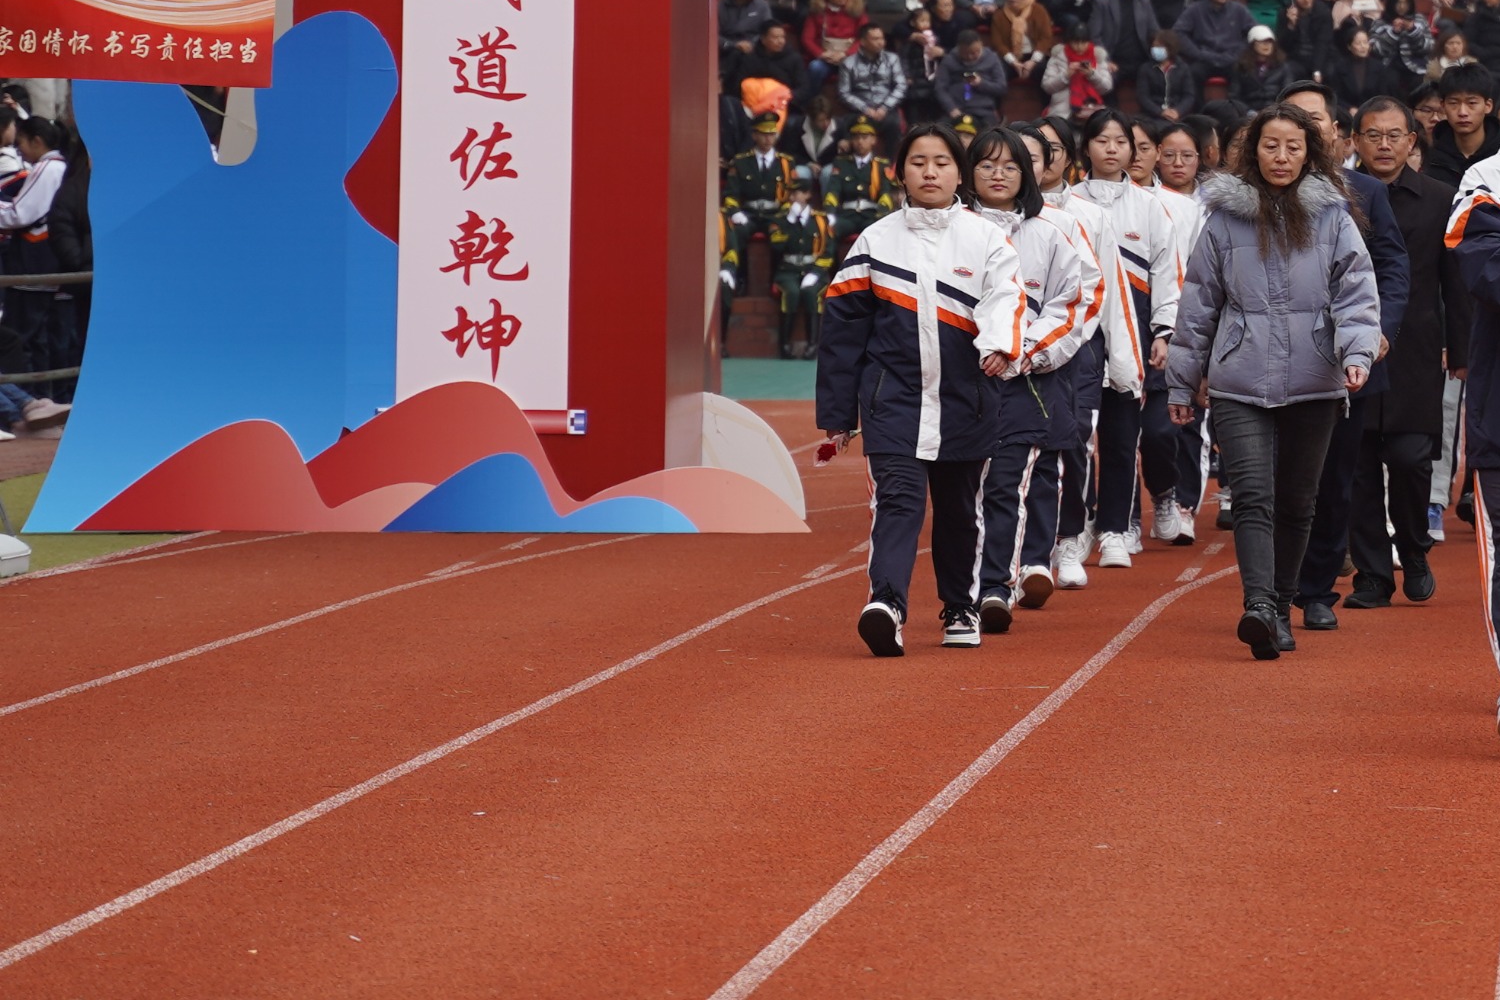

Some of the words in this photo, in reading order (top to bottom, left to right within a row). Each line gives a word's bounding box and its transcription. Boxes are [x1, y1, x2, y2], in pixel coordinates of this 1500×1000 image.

[102, 29, 259, 64] 书写责任担当
